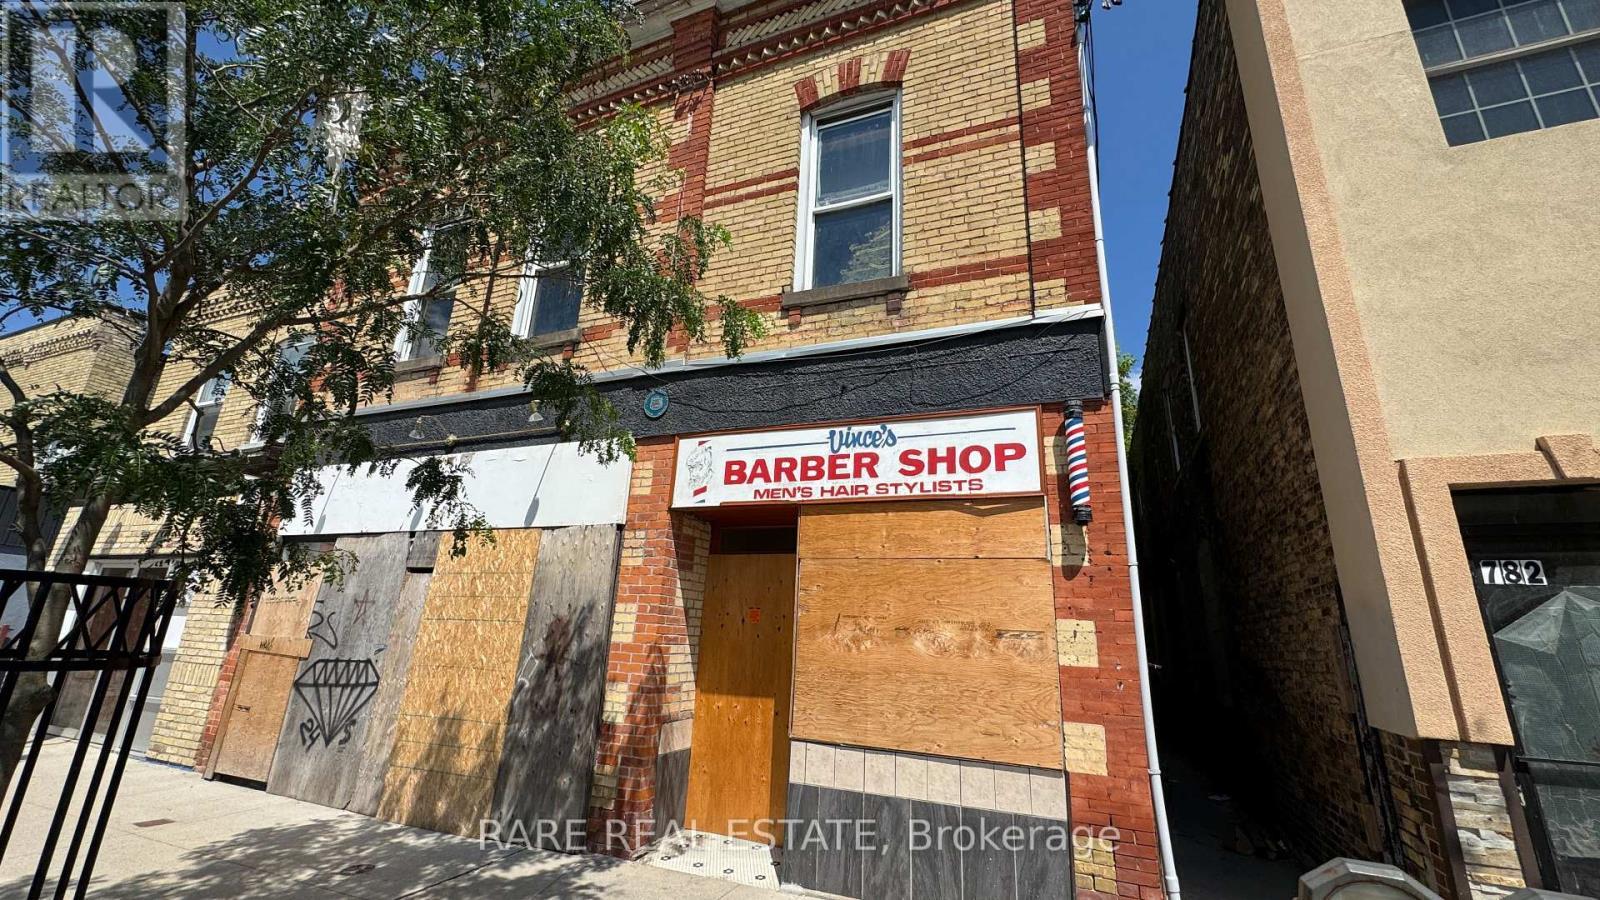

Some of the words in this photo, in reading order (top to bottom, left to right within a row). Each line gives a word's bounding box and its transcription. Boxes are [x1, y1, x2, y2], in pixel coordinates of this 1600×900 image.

[826, 424, 898, 453] Vince's
[723, 452, 879, 486] BARBER
[898, 442, 1027, 477] SHOP
[753, 486, 813, 500] MEN'S
[820, 483, 869, 497] HAIR
[875, 478, 984, 496] STYLISTS
[1481, 561, 1544, 584] 782
